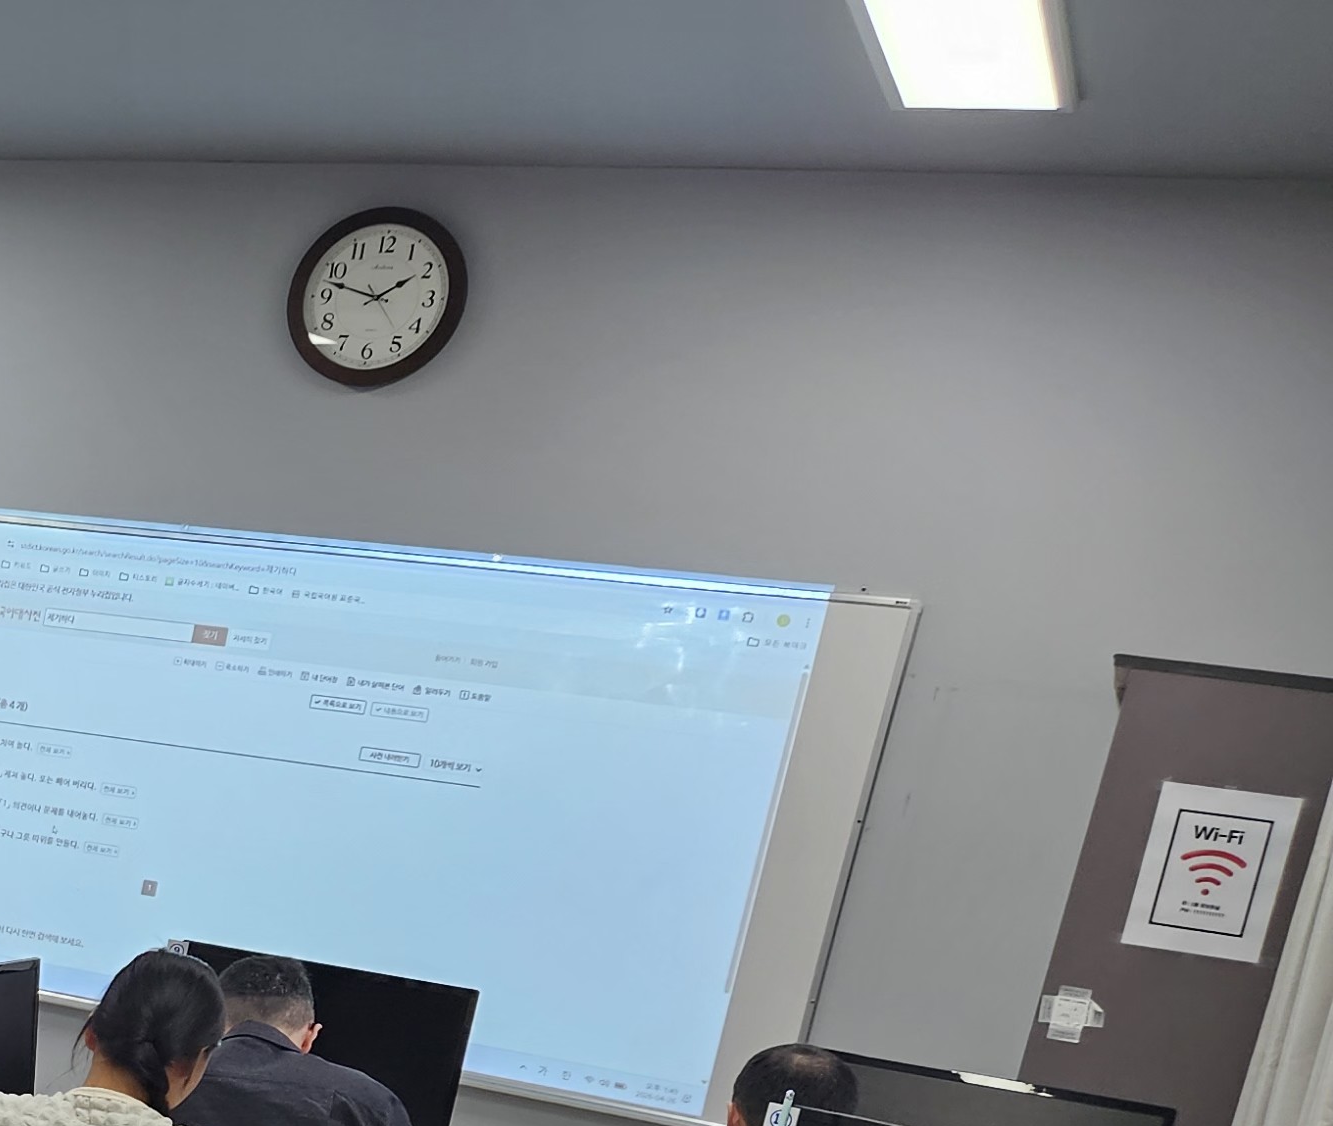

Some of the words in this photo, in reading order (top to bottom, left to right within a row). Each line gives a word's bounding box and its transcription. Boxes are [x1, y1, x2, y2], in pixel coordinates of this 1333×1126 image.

[351, 242, 365, 260] 11
[378, 235, 396, 254] 12
[408, 244, 415, 260] 1
[328, 262, 347, 279] 10
[421, 262, 433, 279] 2
[320, 288, 332, 305] 9
[422, 290, 435, 308] 3
[321, 313, 334, 331] 8
[409, 317, 421, 334] 4
[338, 335, 349, 351] 7
[361, 342, 373, 359] 6
[390, 336, 402, 352] 5
[1193, 824, 1245, 845] Wi-Fi
